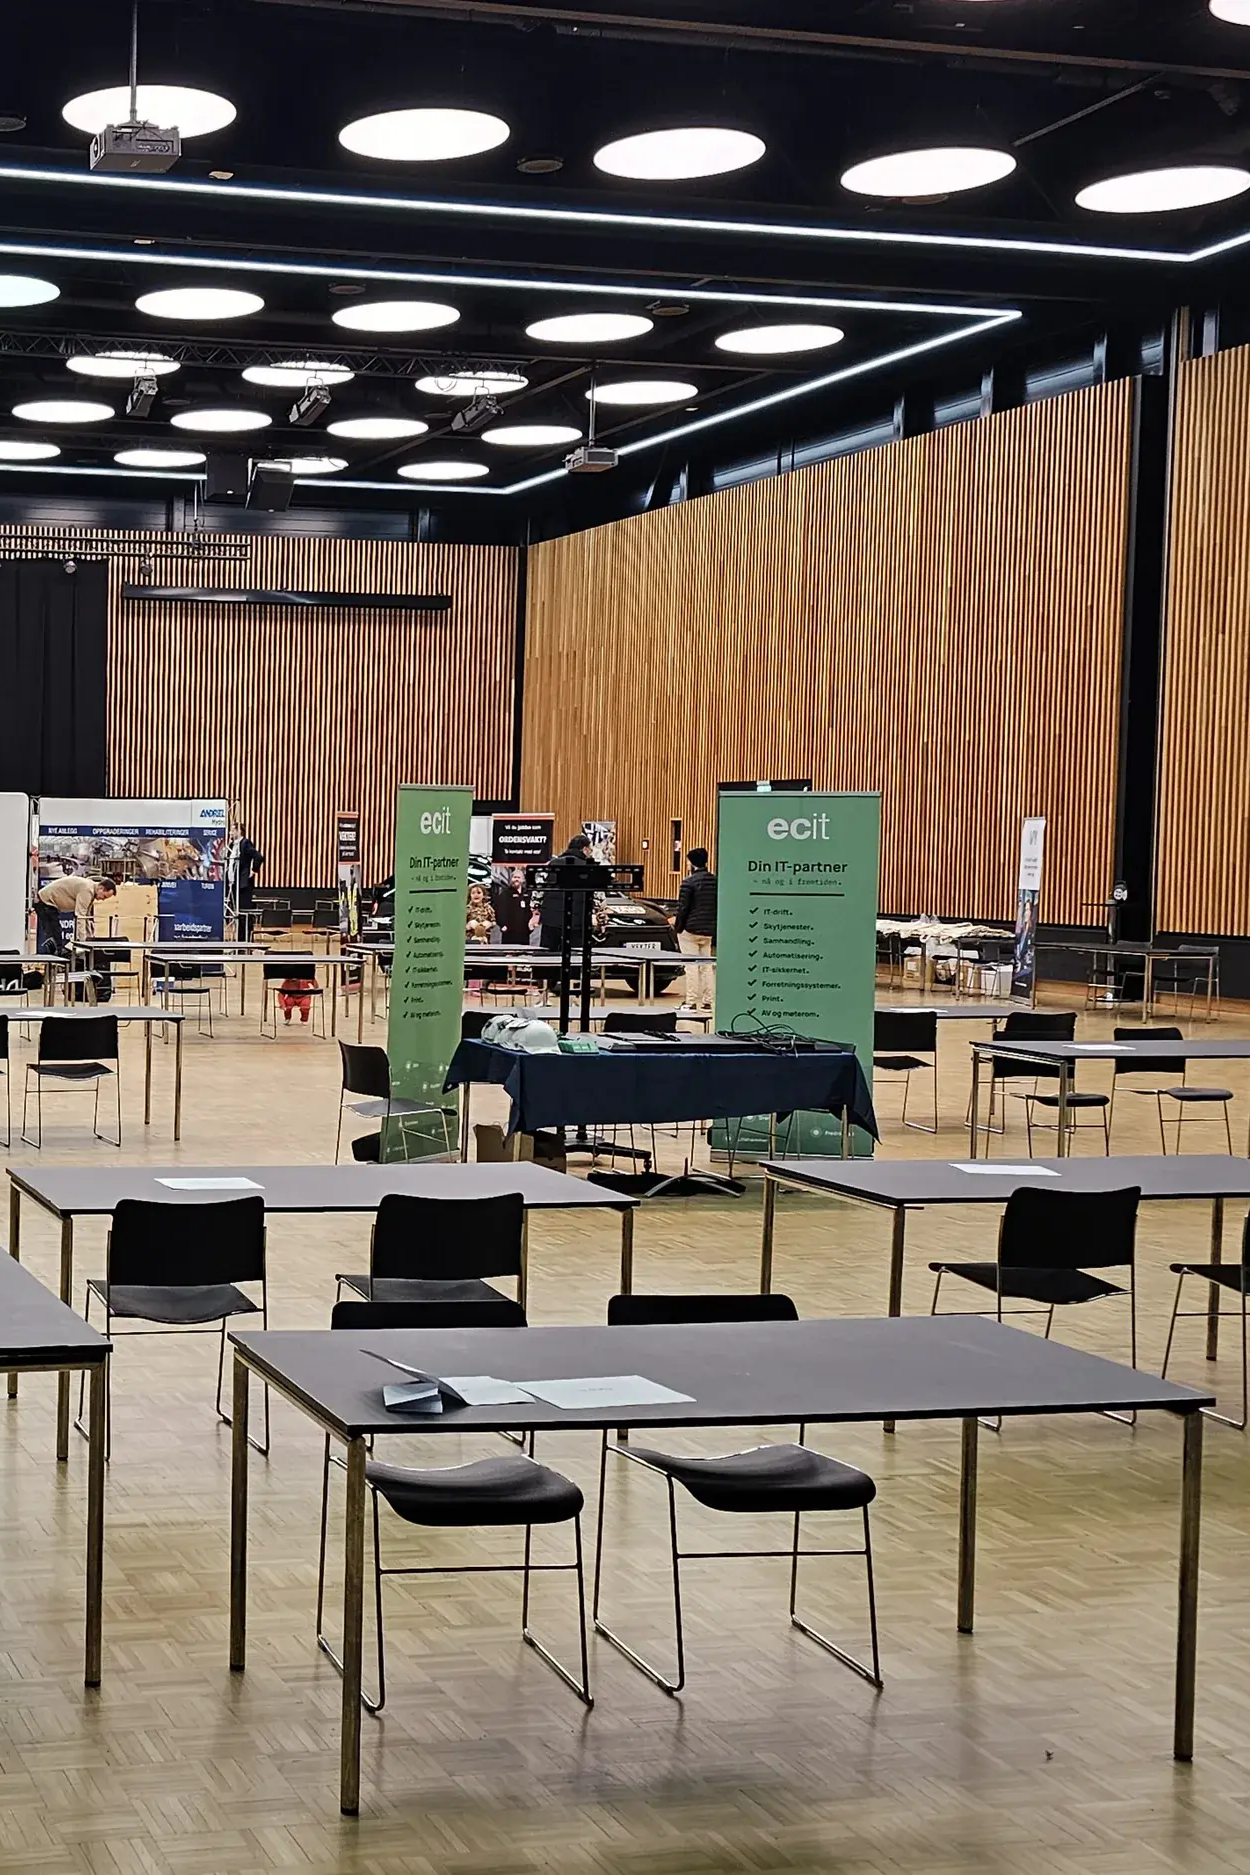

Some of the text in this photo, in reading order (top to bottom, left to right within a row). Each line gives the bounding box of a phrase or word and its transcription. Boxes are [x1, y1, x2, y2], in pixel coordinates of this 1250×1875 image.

[420, 806, 451, 835] ecit
[767, 813, 830, 840] ecit
[409, 856, 459, 871] Din IT-partner
[748, 860, 848, 875] Din IT-partner
[762, 877, 771, 885] nå
[797, 877, 842, 886] fremtiden.
[763, 908, 793, 916] IT-drift.
[763, 922, 814, 932] Skytjenester.
[763, 937, 815, 947] Samhandling.
[763, 951, 823, 961] Automatisering.
[762, 966, 809, 974] IT-sikkerhet.
[762, 980, 841, 990] Forretningssystemer.
[762, 995, 784, 1003] Print.
[761, 1009, 820, 1018] AV og møterom.
